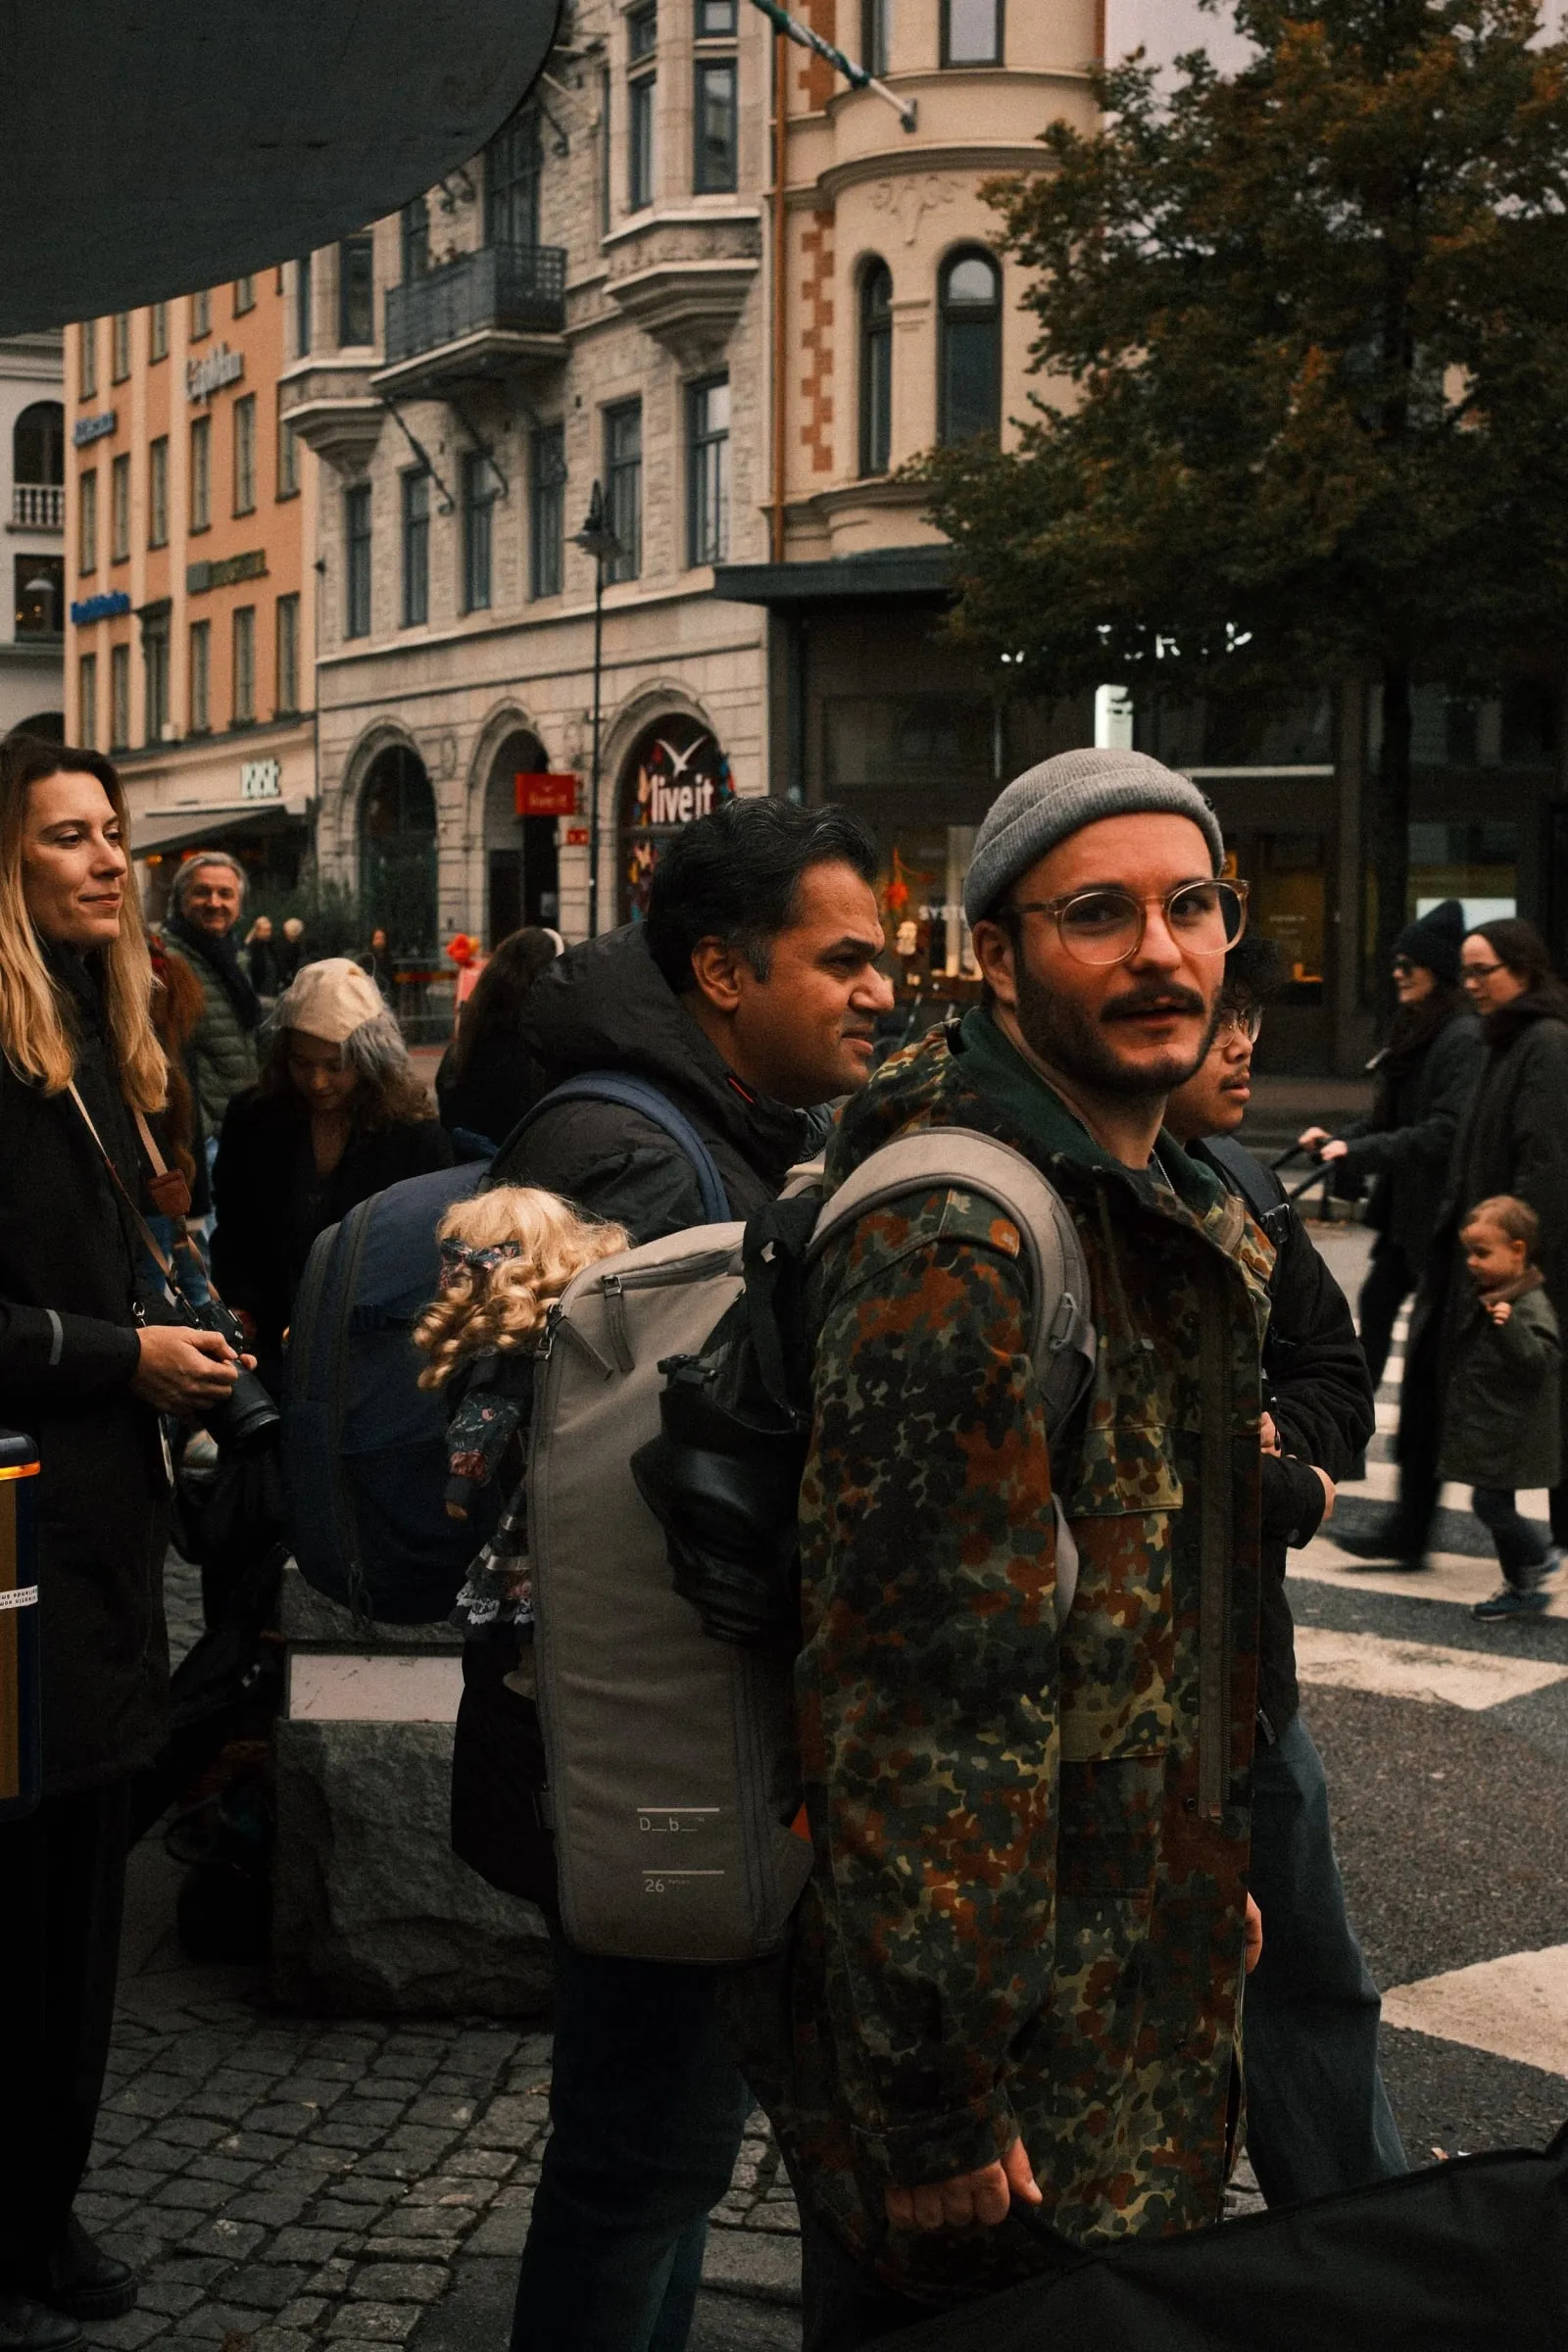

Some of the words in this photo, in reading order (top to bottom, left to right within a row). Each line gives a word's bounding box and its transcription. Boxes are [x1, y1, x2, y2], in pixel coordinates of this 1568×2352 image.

[651, 773, 694, 823] live
[695, 772, 715, 819] it
[644, 1879, 664, 1892] 26
